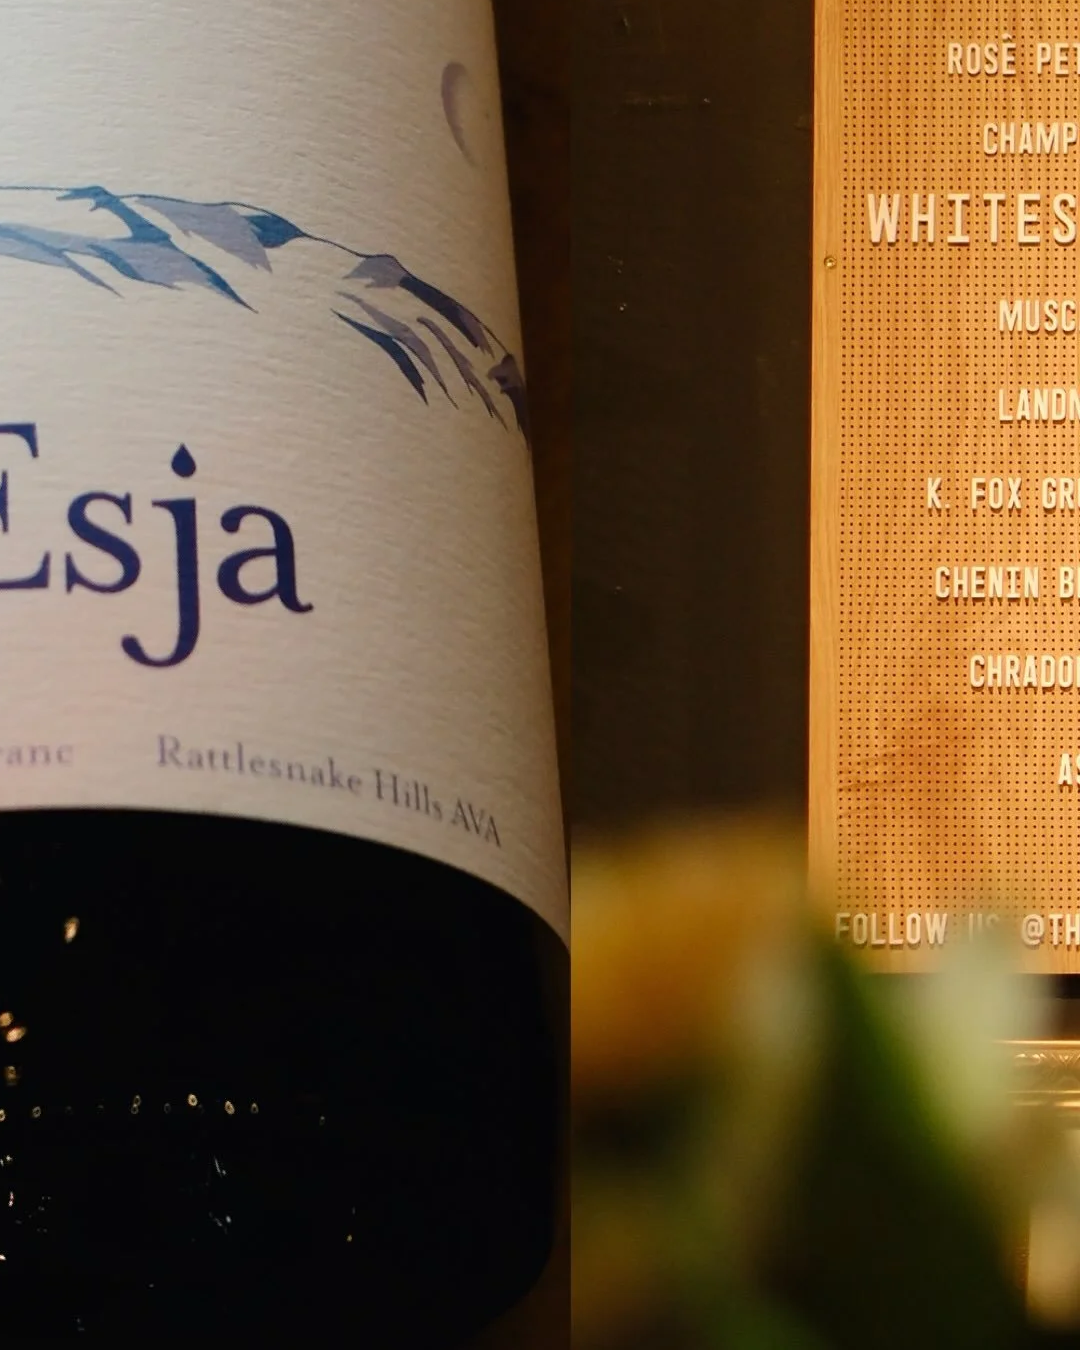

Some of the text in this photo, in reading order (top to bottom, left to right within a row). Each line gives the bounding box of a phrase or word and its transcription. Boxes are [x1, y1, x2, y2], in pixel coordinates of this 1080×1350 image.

[983, 121, 1077, 156] CHAMP
[867, 193, 1077, 245] WHITES
[999, 299, 1080, 333] MUSC
[971, 476, 1022, 511] FOX
[1041, 476, 1080, 511] GR
[935, 565, 1080, 600] CHENIN B
[969, 653, 1080, 689] CHRADO
[156, 733, 503, 849] Rattlesnake Hills AVA
[835, 912, 949, 946] FOLLOW
[1022, 912, 1080, 947] @TH
